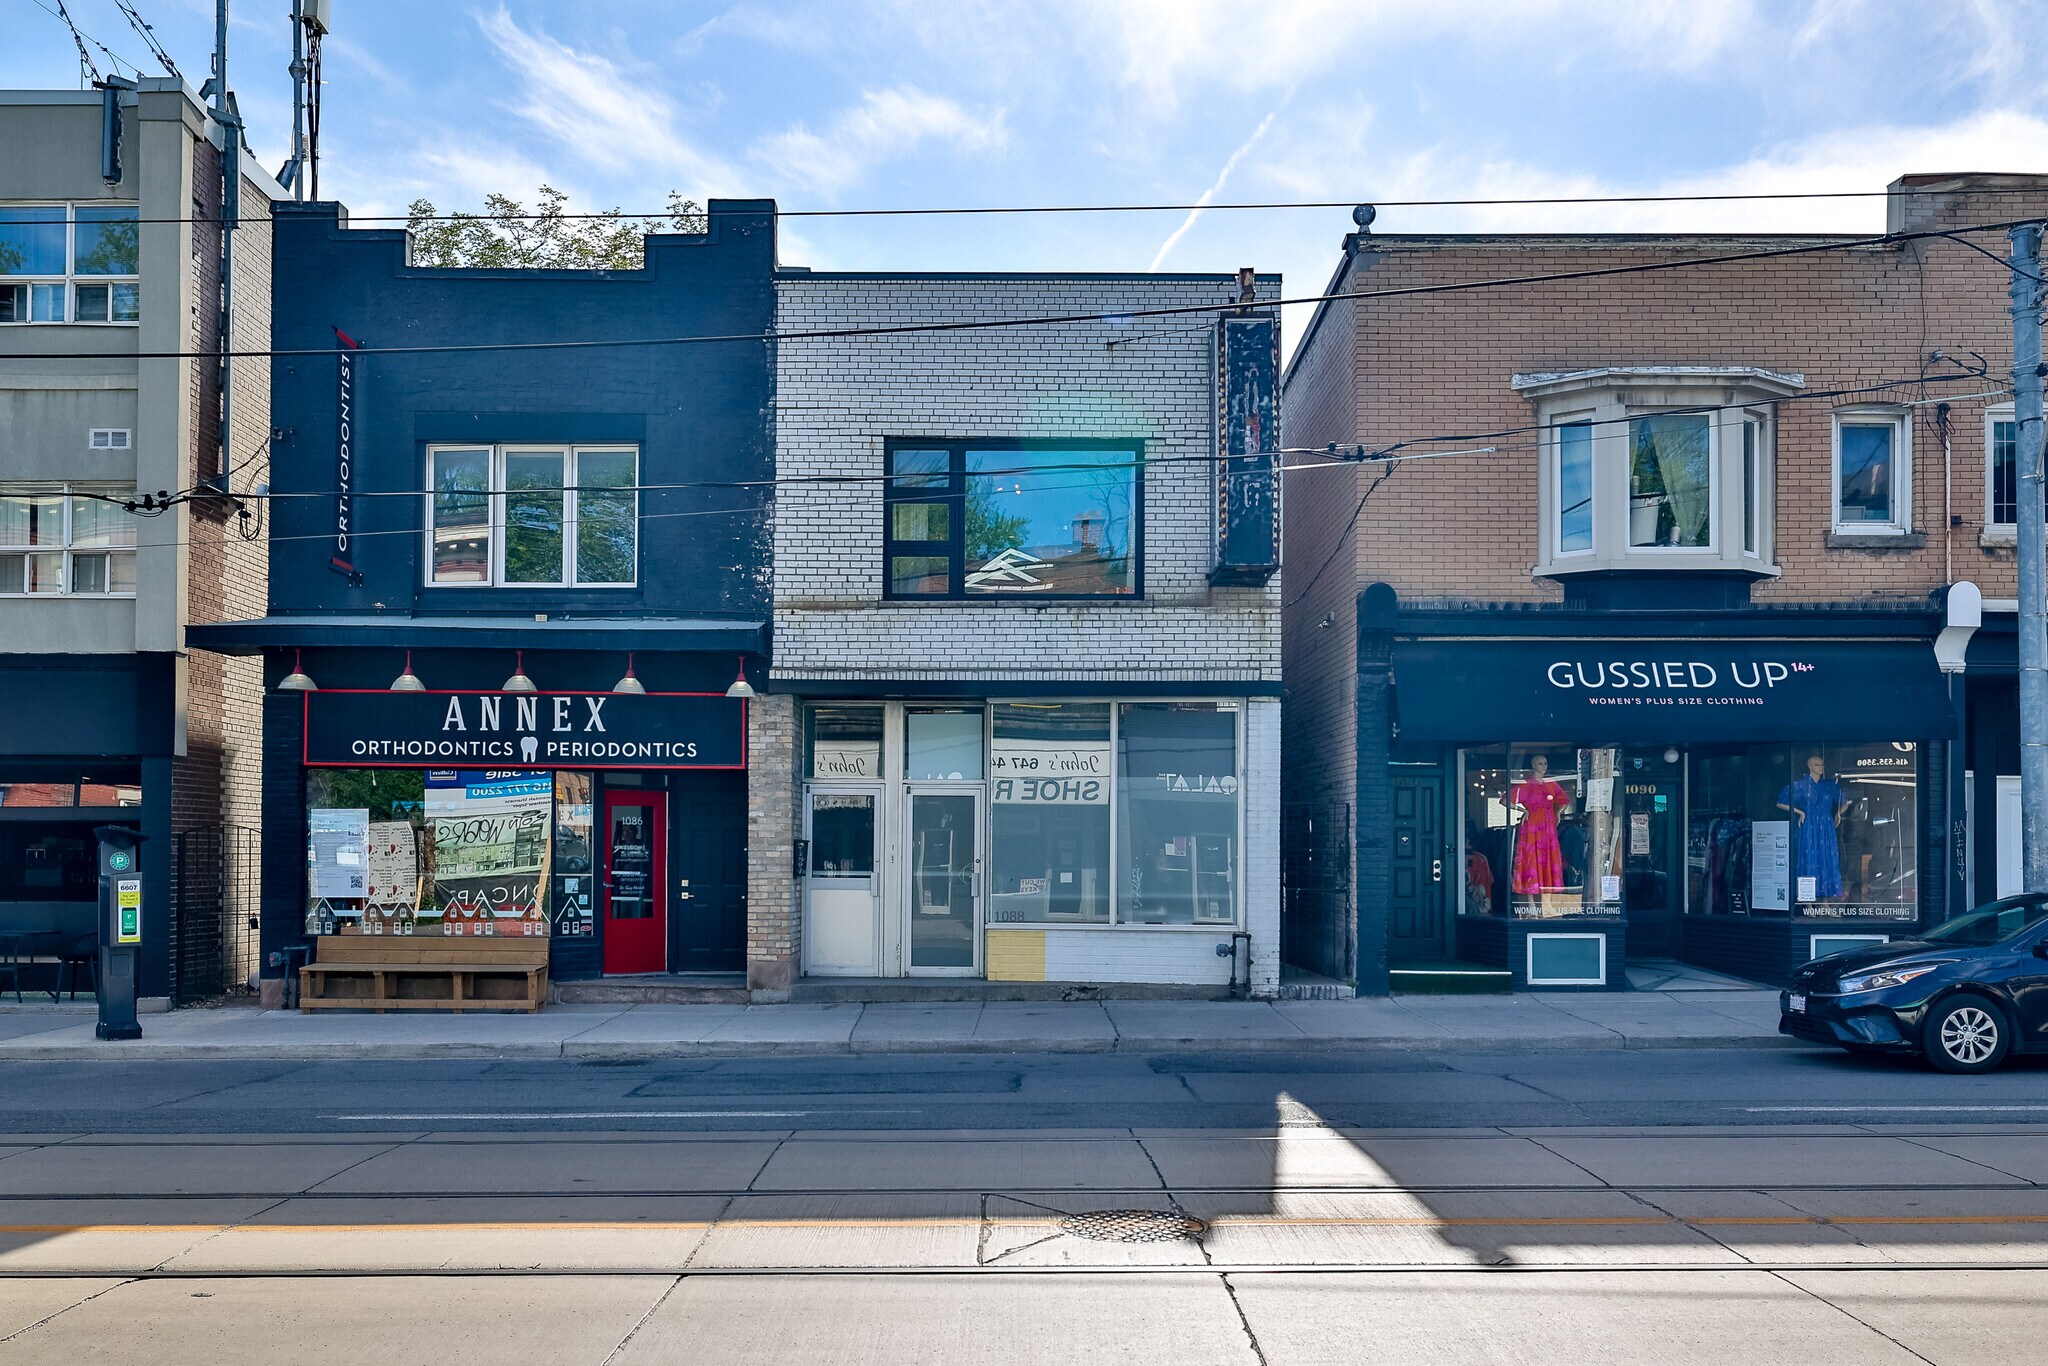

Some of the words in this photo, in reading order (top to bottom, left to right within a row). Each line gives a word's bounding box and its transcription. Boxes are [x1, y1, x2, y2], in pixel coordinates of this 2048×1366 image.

[338, 351, 351, 552] ORTHODONTIST
[1547, 661, 1717, 689] GUSSIED
[1730, 661, 1788, 689] UP
[1791, 662, 1815, 673] 14+
[1589, 697, 1642, 705] WOMEN'S
[1646, 697, 1674, 705] PLUS
[1678, 697, 1703, 705] SIZE
[1707, 697, 1764, 705] CLOTHING
[442, 695, 607, 732] ANNEX
[352, 739, 514, 756] ORTHODONTICS
[547, 741, 698, 757] PERIODONTICS
[1624, 784, 1656, 795] 1090
[621, 816, 643, 826] 1086
[994, 910, 1025, 922] 1088
[1586, 906, 1620, 915] CLOTHING
[1838, 907, 1857, 916] PLUS
[1858, 907, 1874, 916] SIZE
[1875, 907, 1910, 916] CLOTHING
